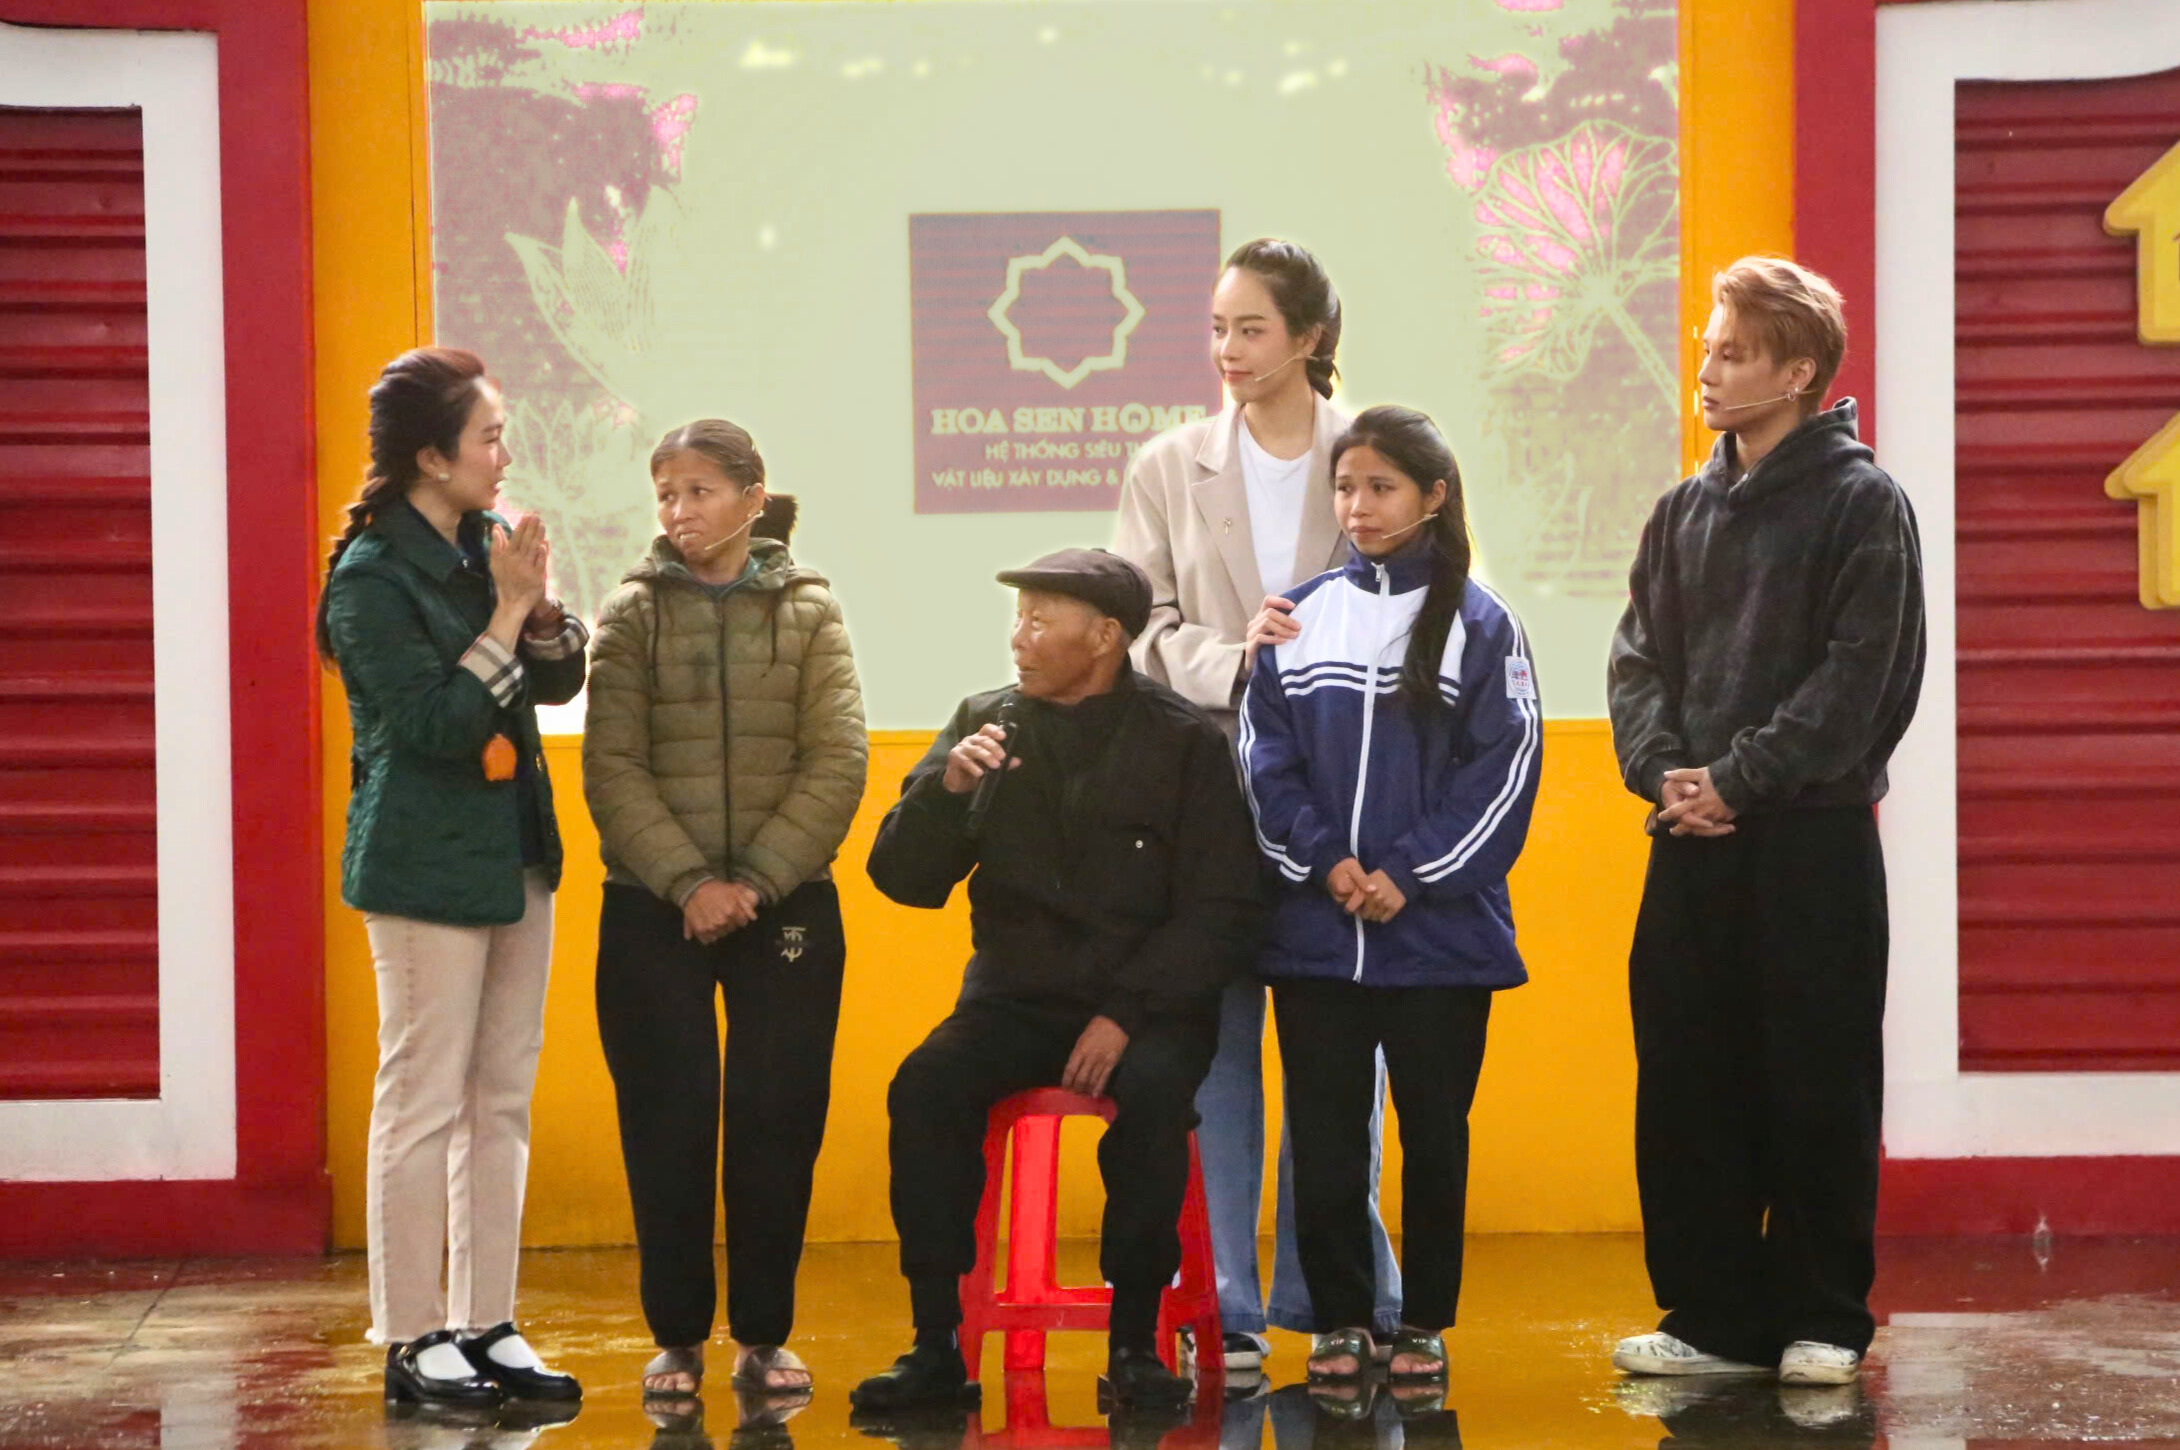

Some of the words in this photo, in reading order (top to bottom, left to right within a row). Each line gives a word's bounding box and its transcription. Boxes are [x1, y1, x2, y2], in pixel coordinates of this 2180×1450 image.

[931, 408, 1009, 434] HOA
[1013, 406, 1085, 433] SEN
[985, 439, 1010, 463] HỆ
[1014, 438, 1080, 460] THỐNG
[931, 468, 965, 491] VẬT
[1008, 467, 1041, 487] XÂY
[1105, 468, 1119, 486] &
[1330, 1338, 1345, 1346] VIP
